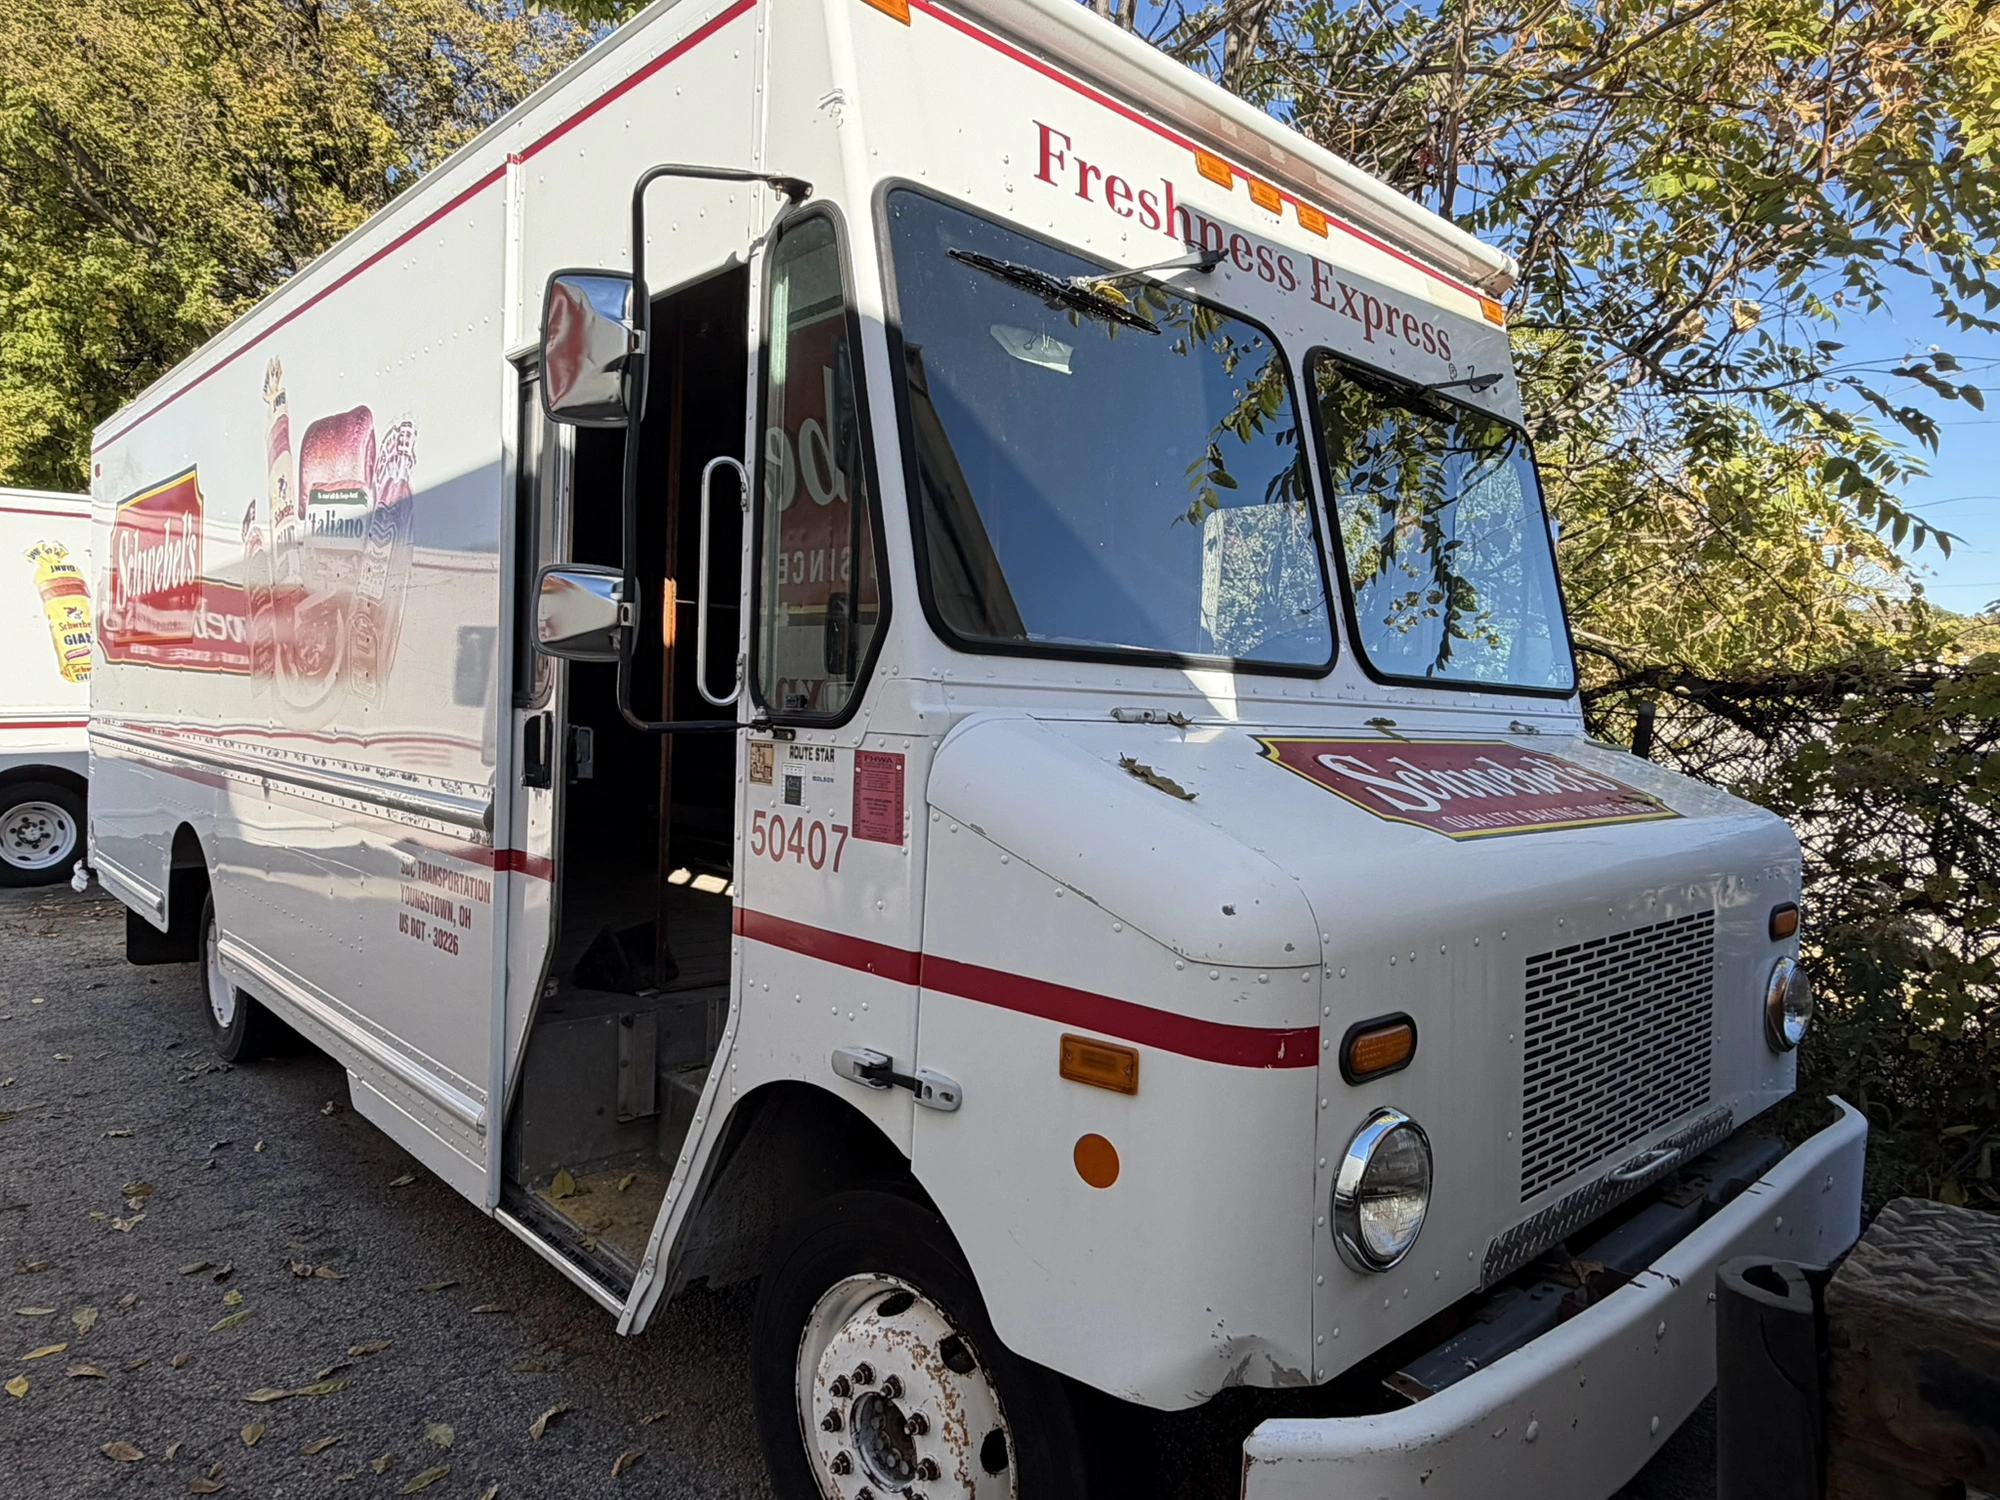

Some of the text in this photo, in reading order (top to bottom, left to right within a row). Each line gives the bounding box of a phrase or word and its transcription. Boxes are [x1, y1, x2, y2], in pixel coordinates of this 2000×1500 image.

[1032, 119, 1452, 362] Freshness Express
[117, 509, 197, 611] Schwebel's
[59, 620, 91, 632] Schwebe
[789, 745, 835, 763] ROUTE STAR
[1315, 753, 1619, 813] Schwebel's
[1442, 811, 1524, 829] QUALITY
[1517, 806, 1580, 822] BAKING
[1576, 803, 1630, 817] SINCE
[751, 810, 849, 873] 50407
[417, 861, 491, 904] TRANSPORTATION
[400, 884, 472, 930] YOUNGSTOWN, OH
[399, 912, 409, 934] US
[411, 917, 426, 941] DOT
[433, 926, 459, 956] 30226
